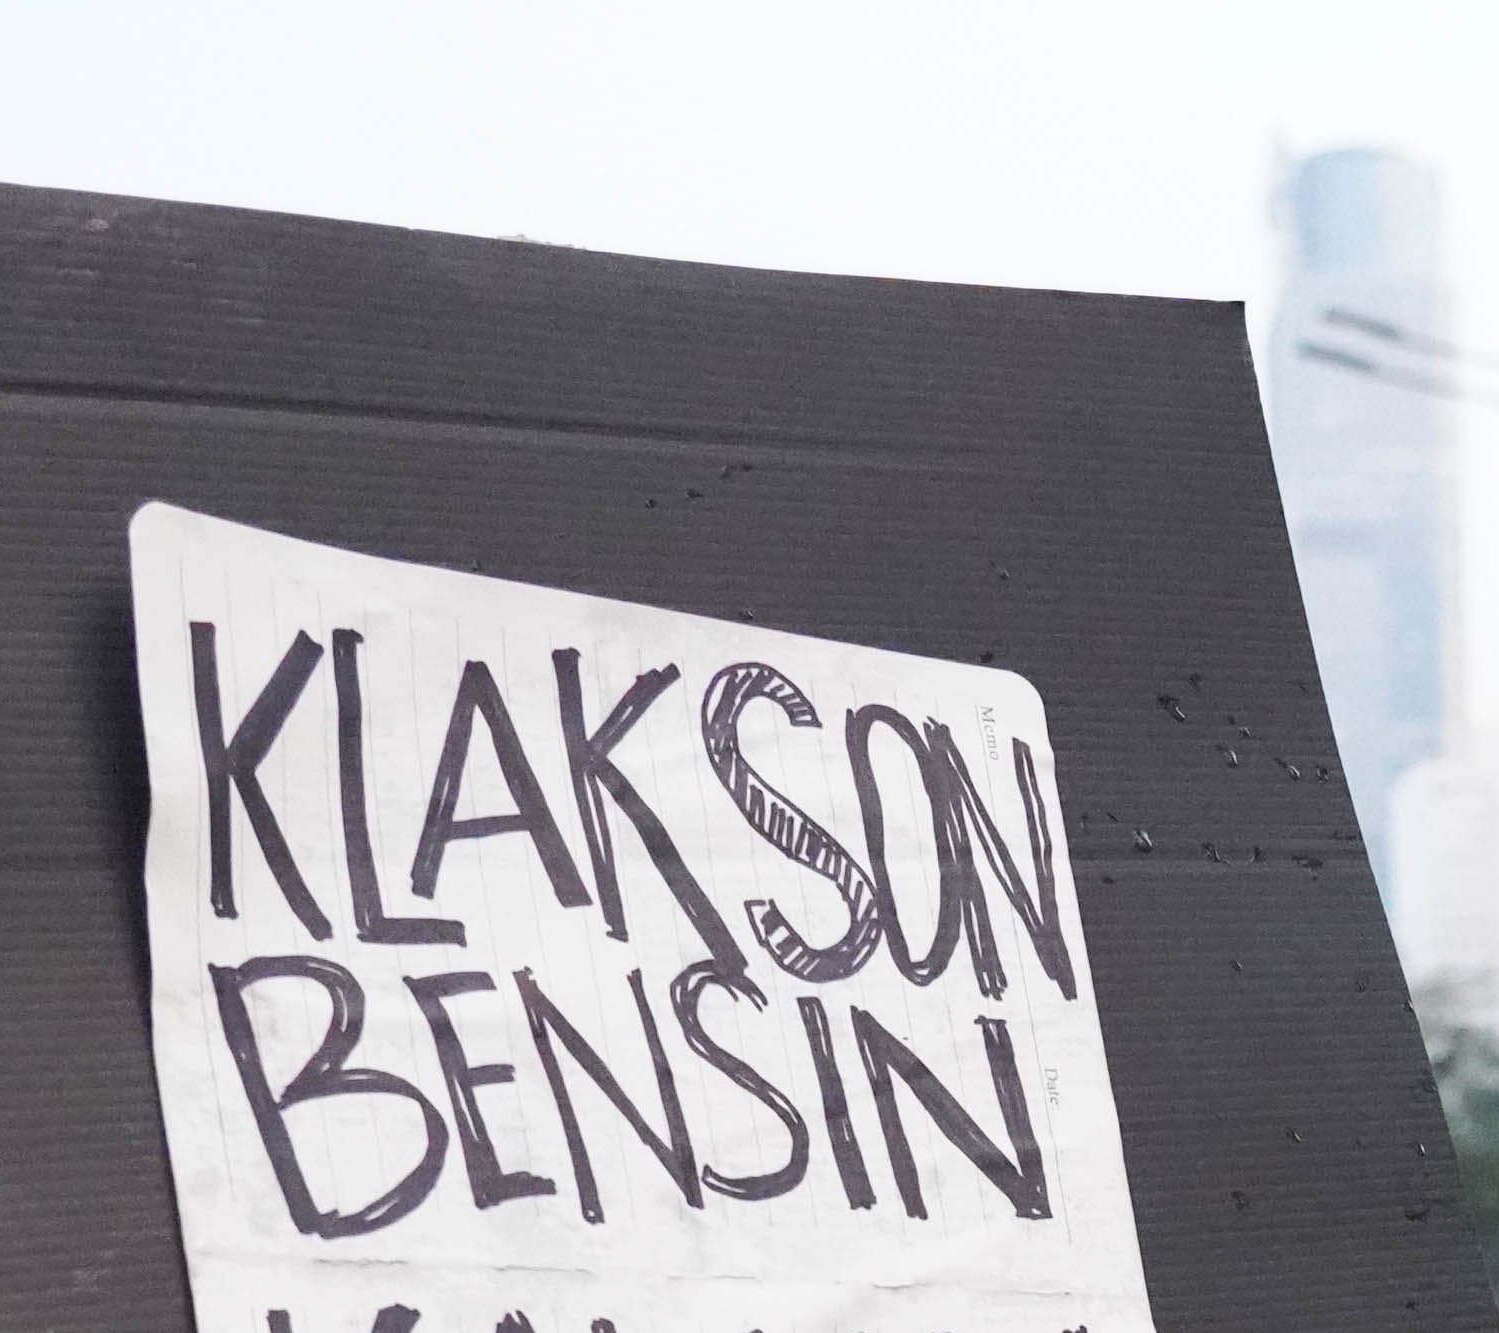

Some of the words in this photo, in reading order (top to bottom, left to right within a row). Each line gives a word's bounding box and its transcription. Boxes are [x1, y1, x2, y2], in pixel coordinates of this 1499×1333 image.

[189, 621, 1079, 1000] KLAKSON
[978, 704, 1000, 762] Memo
[207, 954, 1053, 1241] BENSIN
